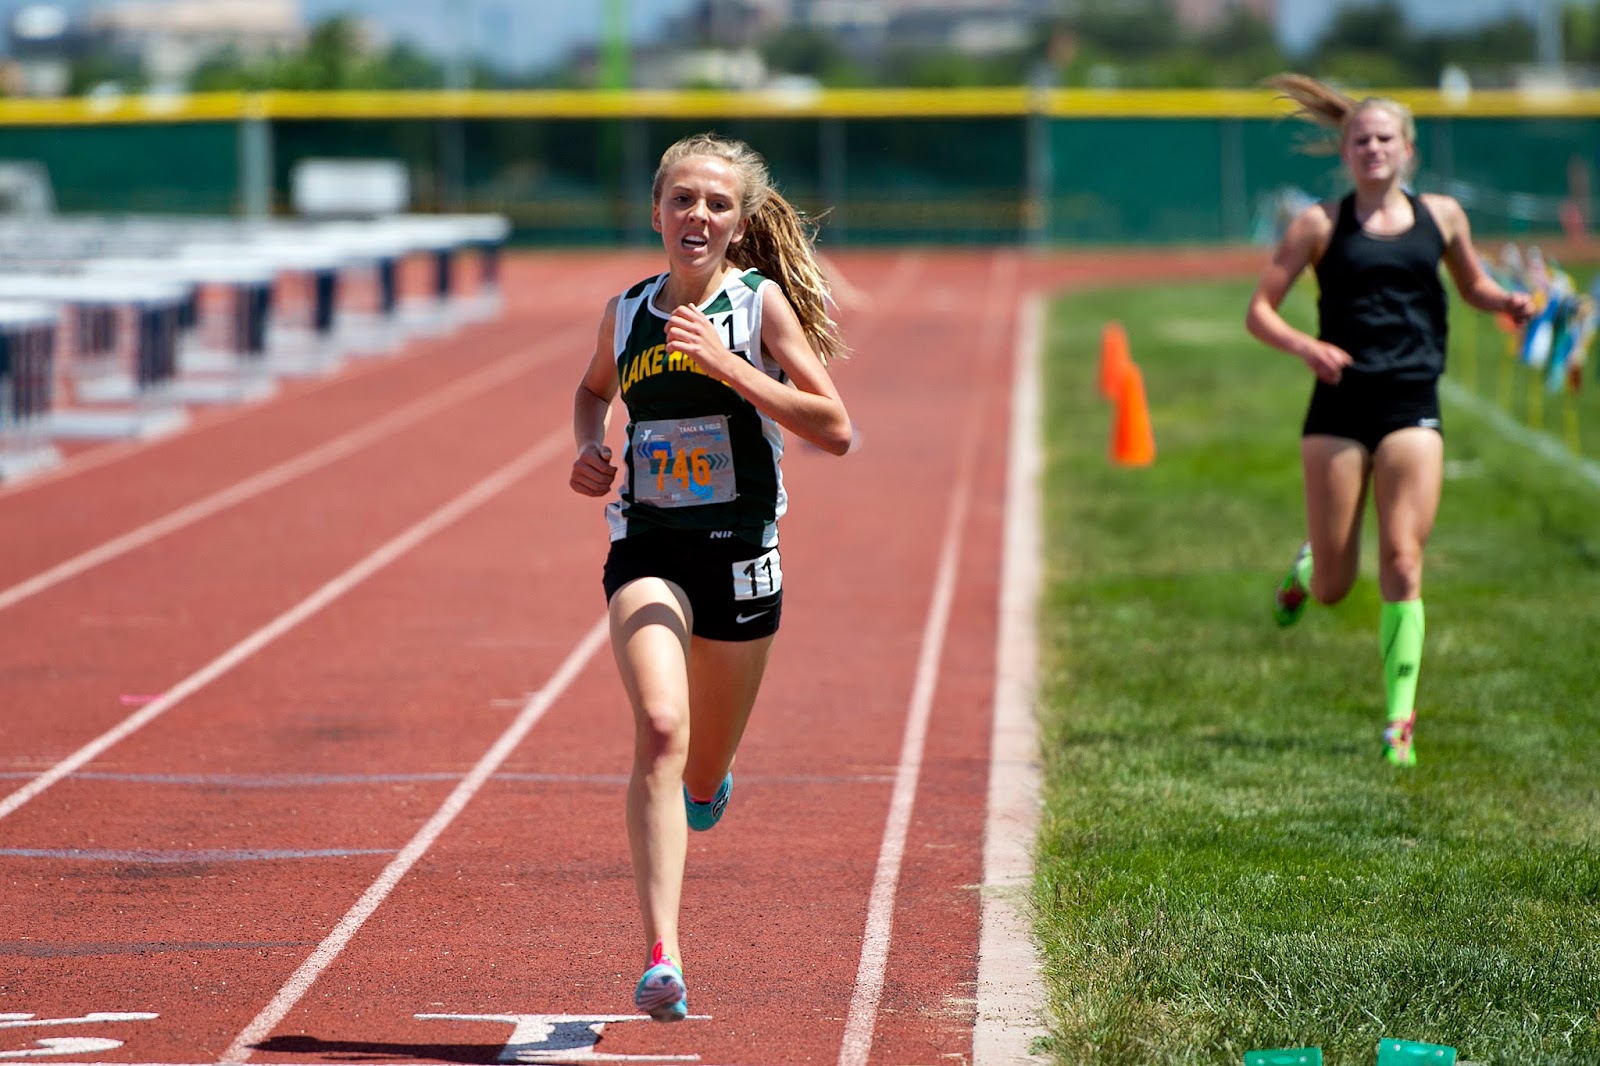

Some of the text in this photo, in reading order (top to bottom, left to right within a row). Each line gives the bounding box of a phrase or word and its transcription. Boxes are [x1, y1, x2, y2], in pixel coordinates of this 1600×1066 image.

[708, 314, 735, 350] 1
[621, 344, 666, 394] LAKE
[652, 447, 712, 491] 746
[743, 557, 774, 597] 11
